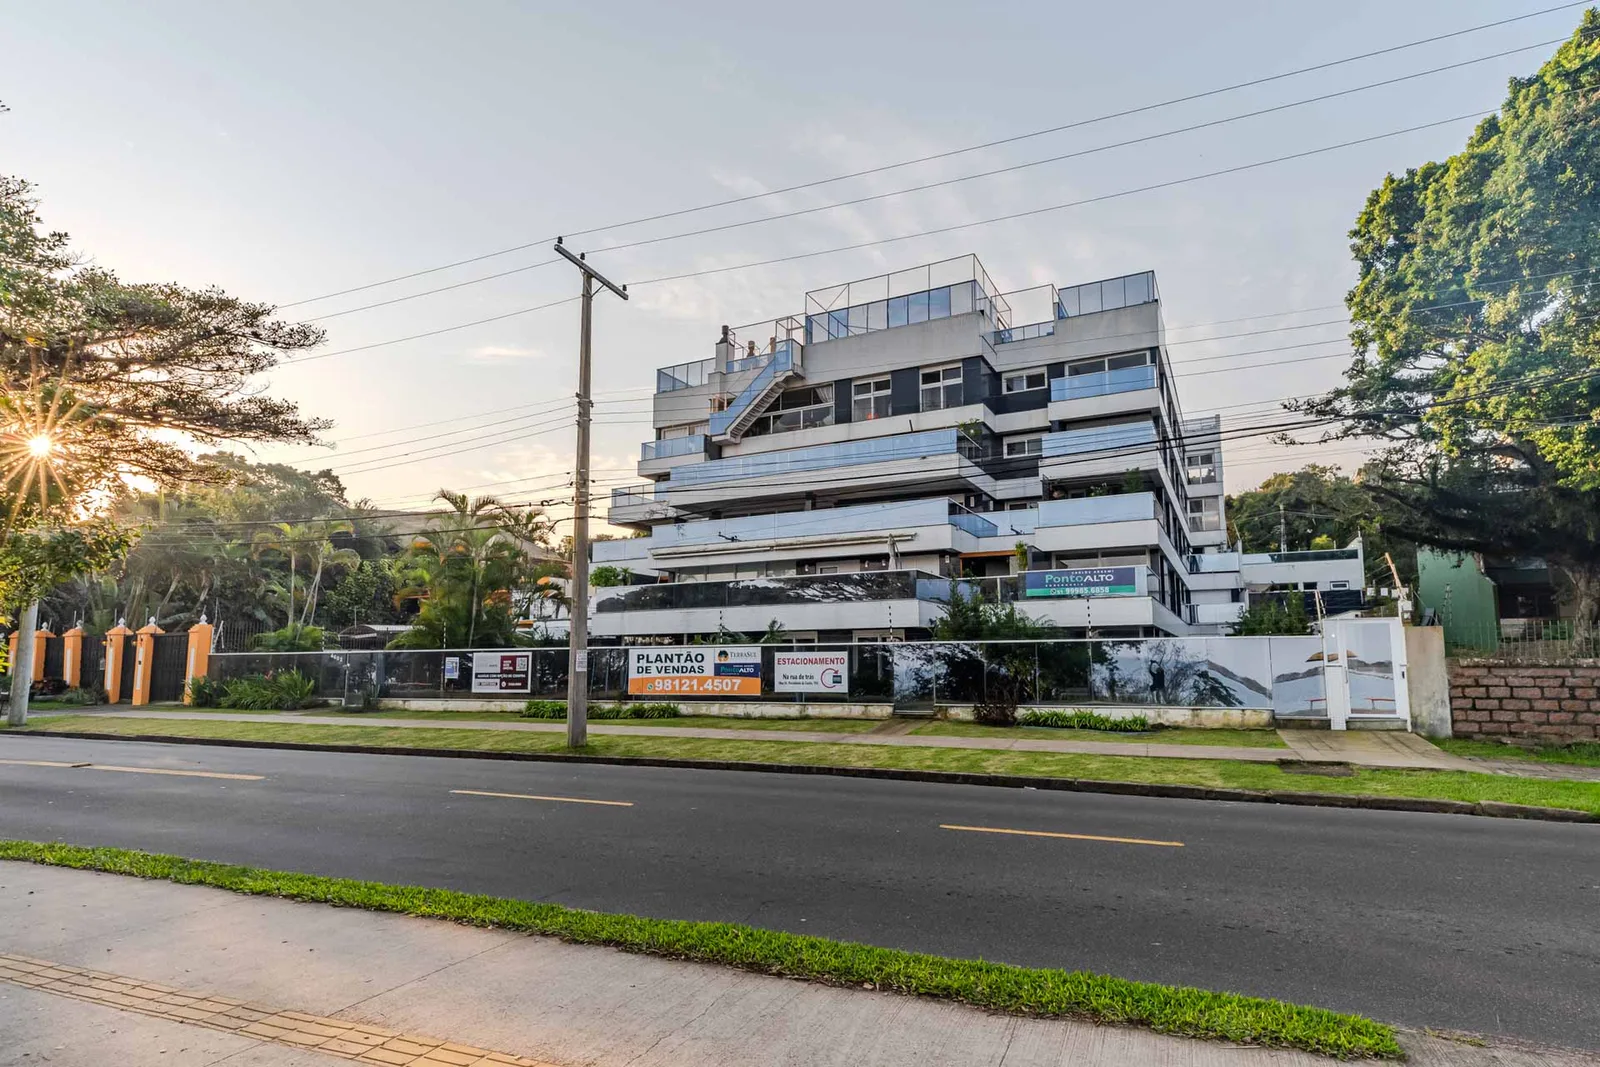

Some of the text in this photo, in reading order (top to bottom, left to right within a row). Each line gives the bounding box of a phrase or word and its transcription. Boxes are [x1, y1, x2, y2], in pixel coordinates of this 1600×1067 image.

[1045, 574, 1114, 583] PontoALTO
[637, 651, 705, 663] PLANTÃO
[777, 657, 846, 665] ESTACIONAMENTO
[636, 665, 705, 674] DE VENDAS
[655, 679, 742, 691] 98121.4507
